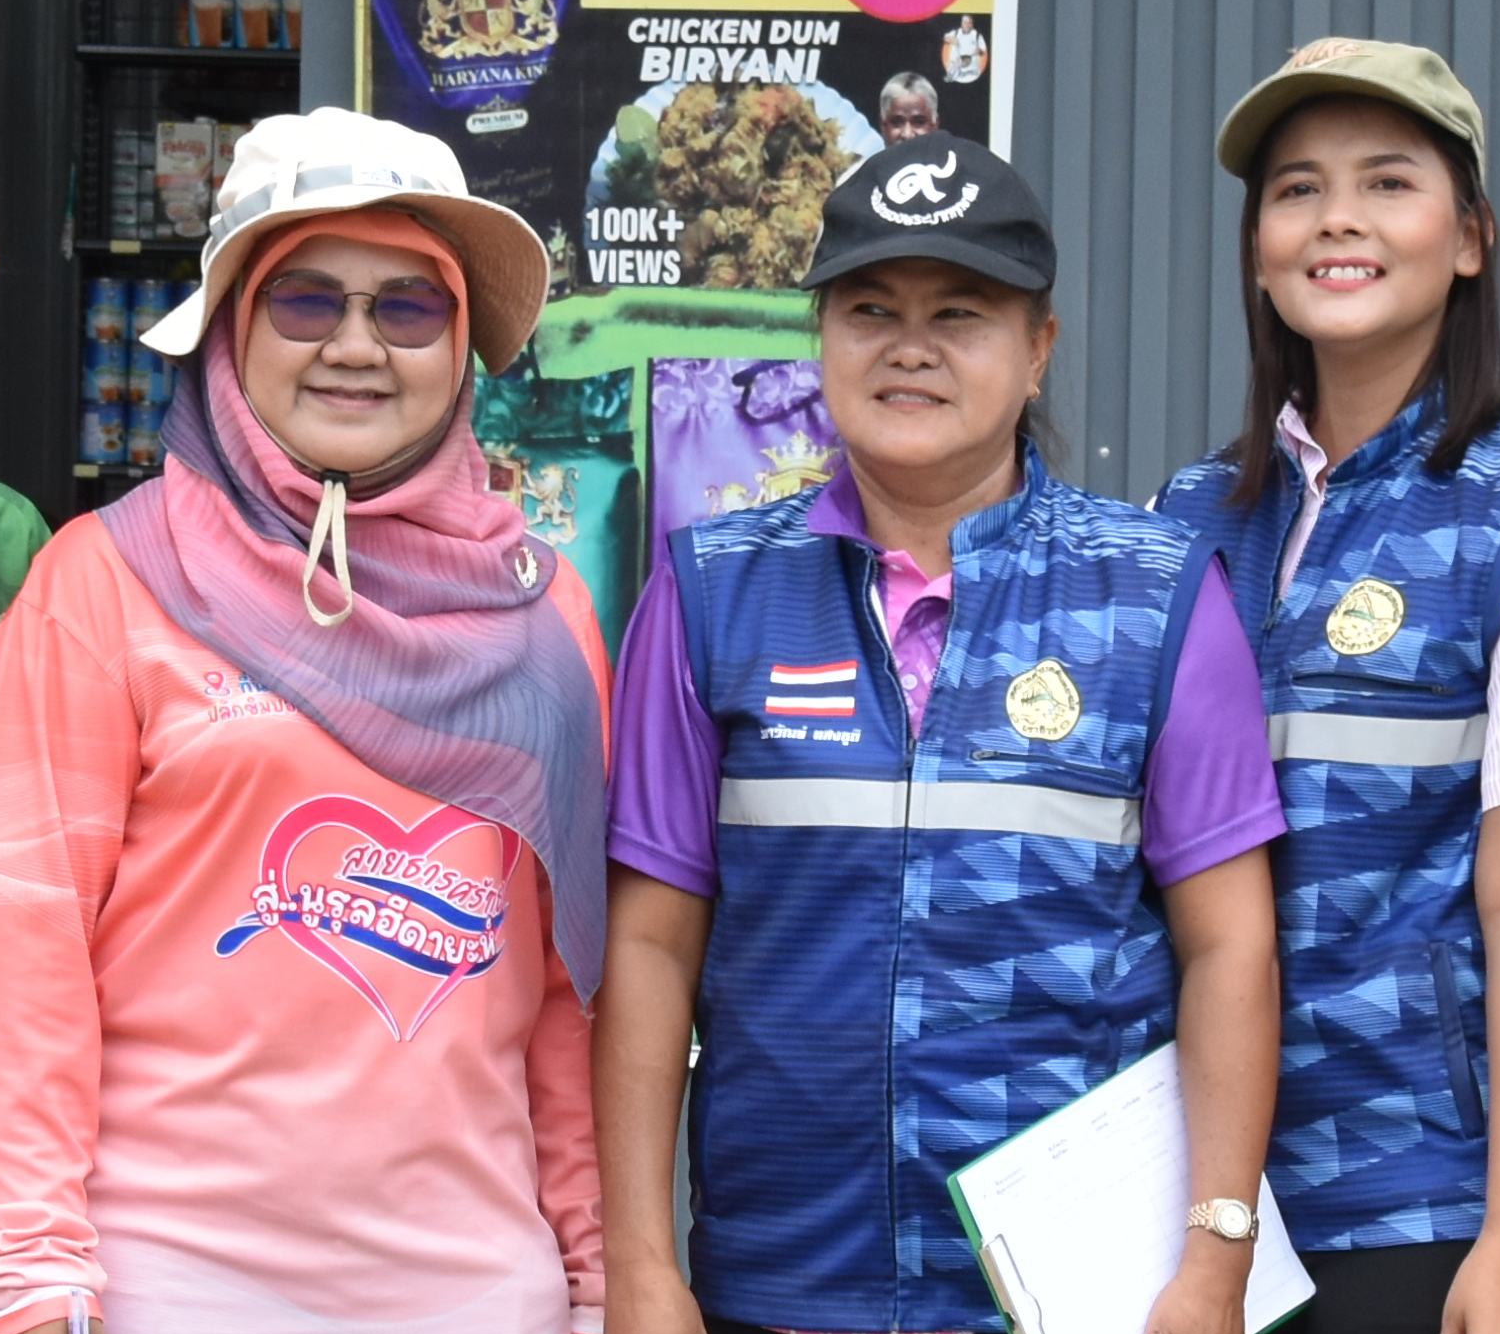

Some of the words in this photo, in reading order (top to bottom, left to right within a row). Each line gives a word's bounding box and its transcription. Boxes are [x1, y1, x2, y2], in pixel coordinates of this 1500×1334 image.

[627, 17, 760, 46] CHICKEN
[768, 19, 839, 47] DUM
[433, 66, 513, 87] HARYANA
[515, 63, 548, 81] KIN
[640, 46, 821, 86] BIRYANI
[586, 208, 684, 243] 100K+
[588, 249, 681, 285] VIEWS
